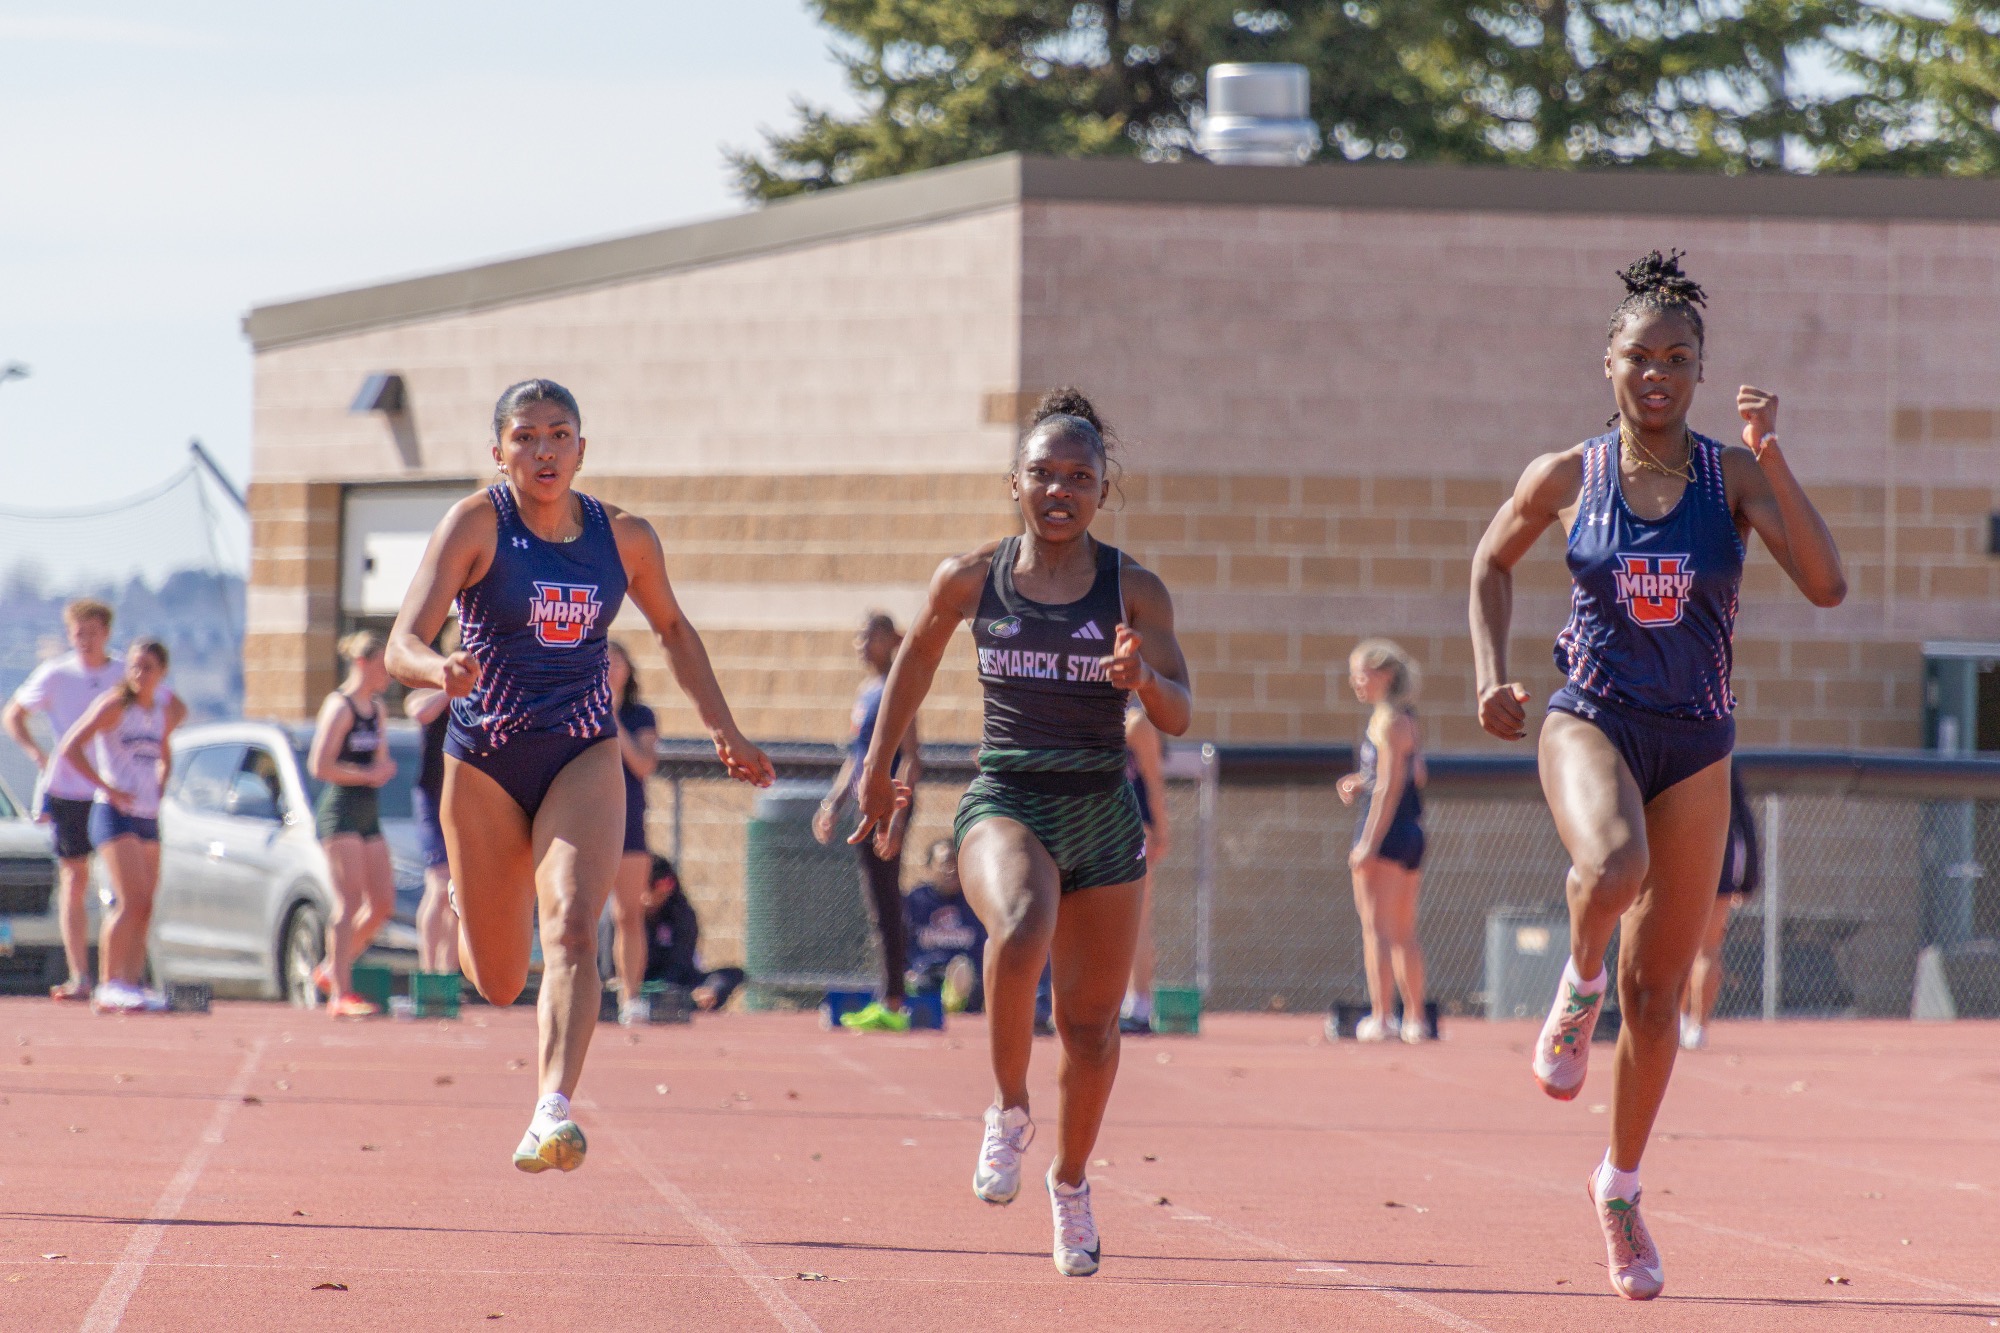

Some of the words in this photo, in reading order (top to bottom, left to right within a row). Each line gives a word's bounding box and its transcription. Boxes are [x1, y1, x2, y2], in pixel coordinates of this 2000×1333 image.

[1618, 573, 1690, 599] MARY
[1620, 555, 1687, 626] U
[532, 600, 598, 626] MARY
[536, 583, 596, 645] U
[978, 647, 1058, 680] BISMARCK
[1067, 655, 1113, 682] STA
